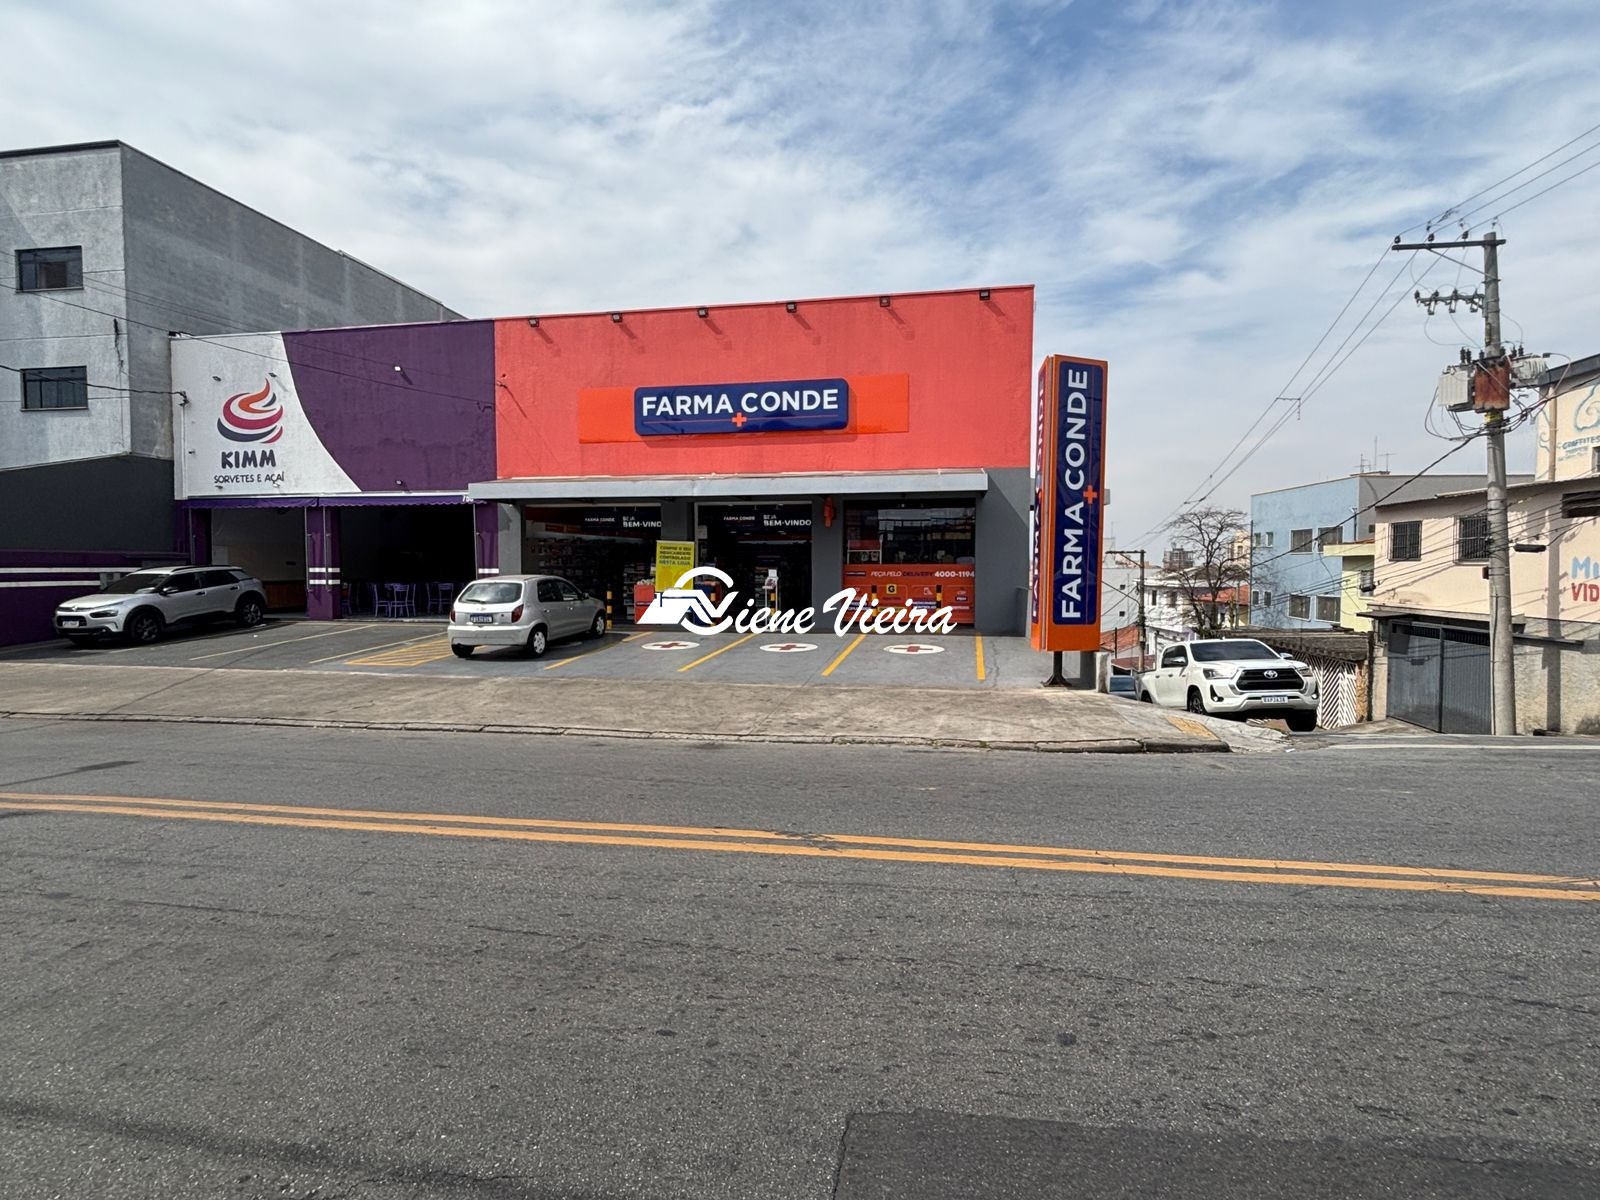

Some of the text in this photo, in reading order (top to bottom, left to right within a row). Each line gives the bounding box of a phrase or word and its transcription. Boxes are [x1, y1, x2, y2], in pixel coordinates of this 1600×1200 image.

[642, 389, 839, 416] FARMA CONDE
[221, 449, 276, 469] KIMM
[214, 471, 285, 484] SORVETES E AÇAÍ
[1061, 369, 1089, 618] FARMA CONDE
[763, 519, 812, 527] BEM-VINDO
